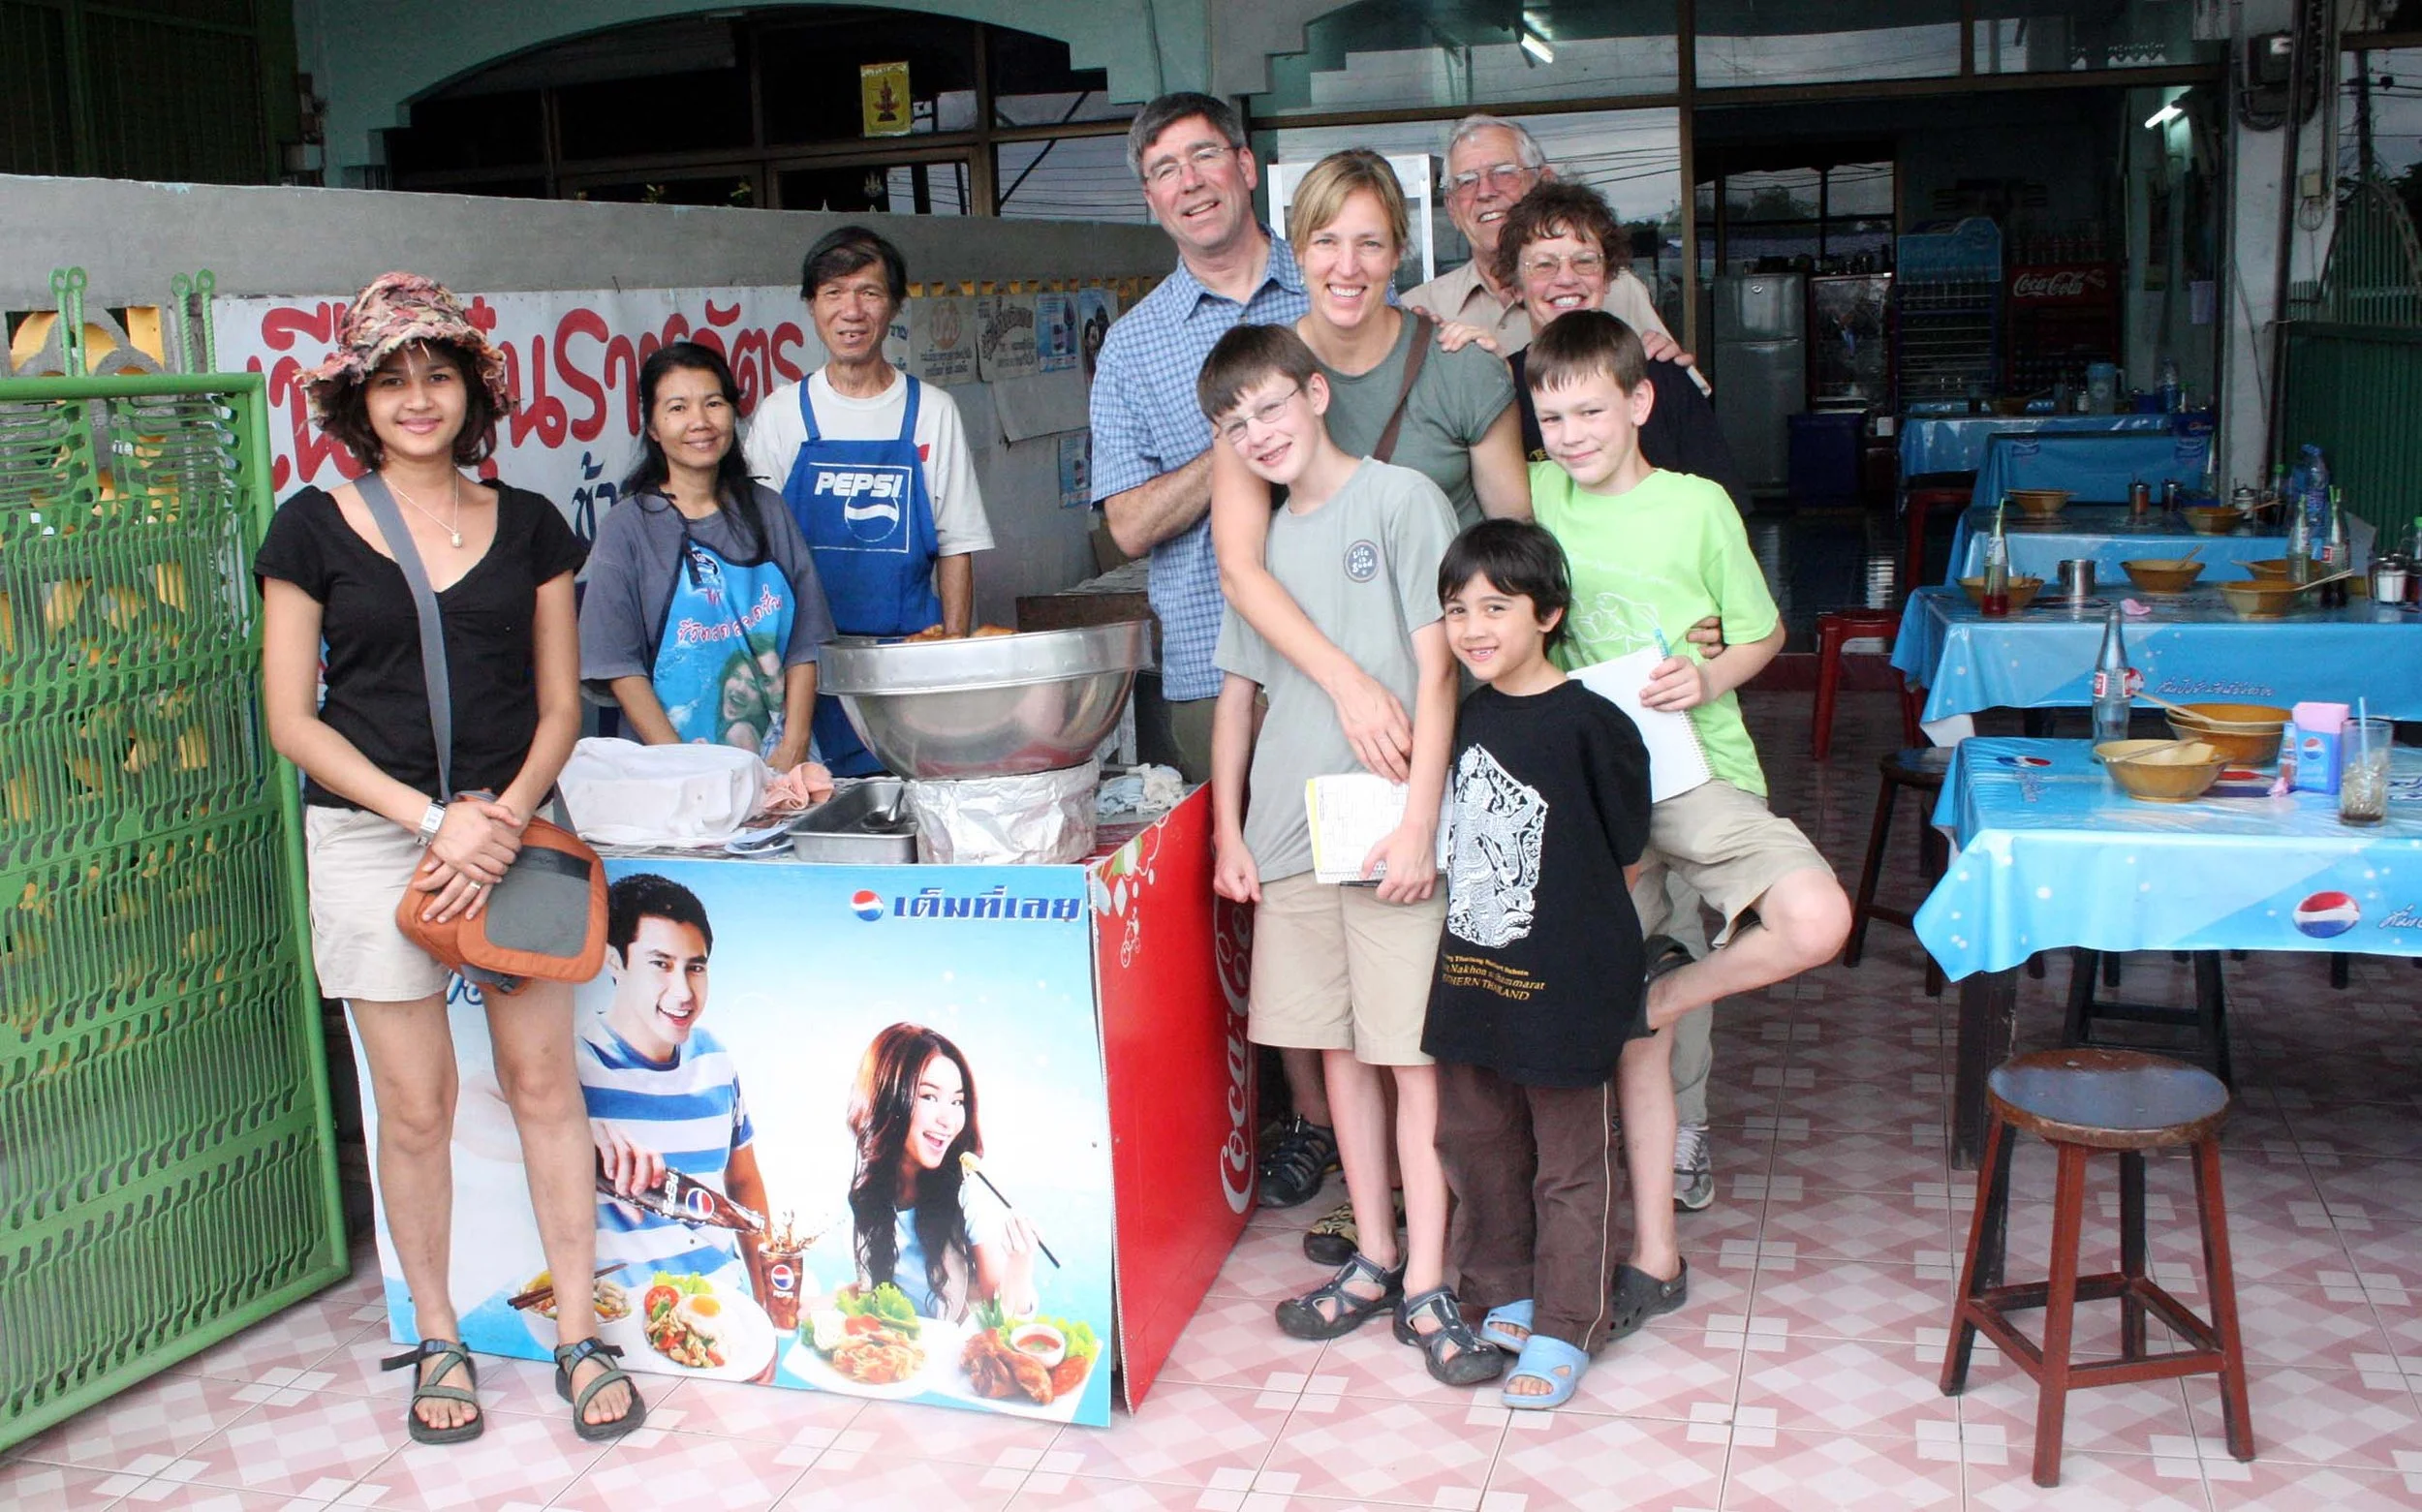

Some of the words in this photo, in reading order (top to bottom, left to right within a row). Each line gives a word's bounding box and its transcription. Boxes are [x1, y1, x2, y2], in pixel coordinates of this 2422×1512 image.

[2013, 271, 2086, 297] Coca-Cola
[814, 471, 904, 498] PEPSI
[893, 885, 1083, 922] เต็มที่เลย
[1443, 972, 1480, 987] HERN
